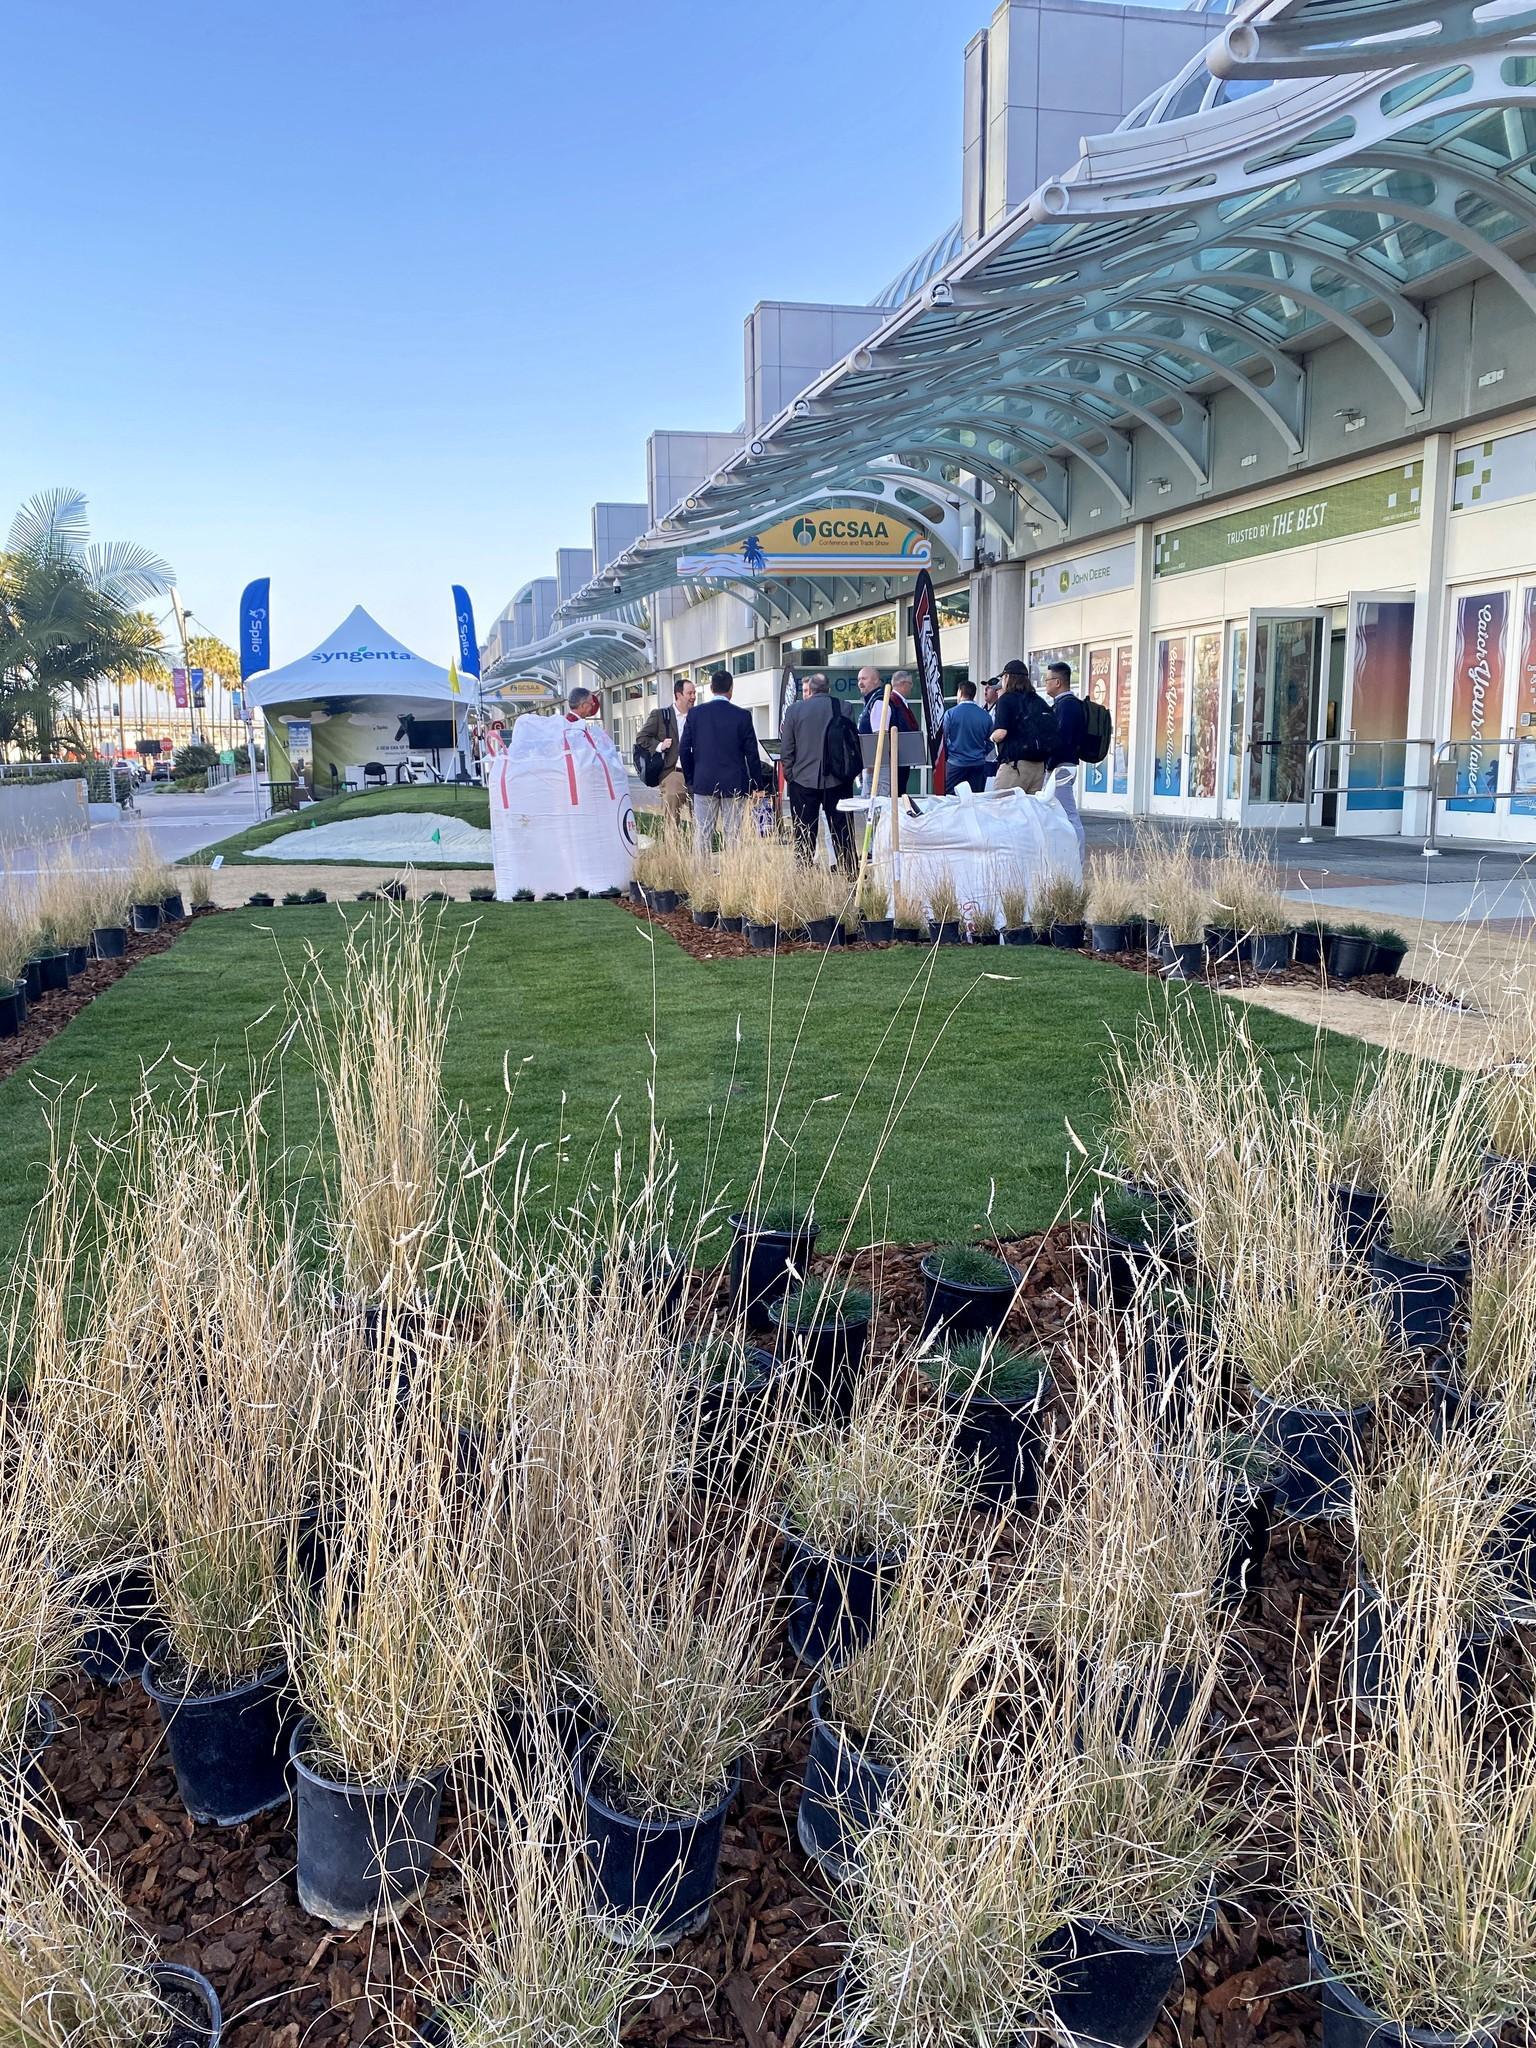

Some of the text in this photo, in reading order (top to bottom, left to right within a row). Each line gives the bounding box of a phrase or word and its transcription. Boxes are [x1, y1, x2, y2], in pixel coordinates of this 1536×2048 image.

[818, 520, 889, 538] GCSAA
[1226, 502, 1329, 545] TRUSTED BY THE BEST
[1089, 566, 1111, 581] DEERE
[1475, 603, 1492, 661] Catch
[311, 650, 412, 664] syngenta
[1168, 646, 1178, 688] Catch
[1165, 685, 1178, 738] Your
[1468, 659, 1492, 732] Your
